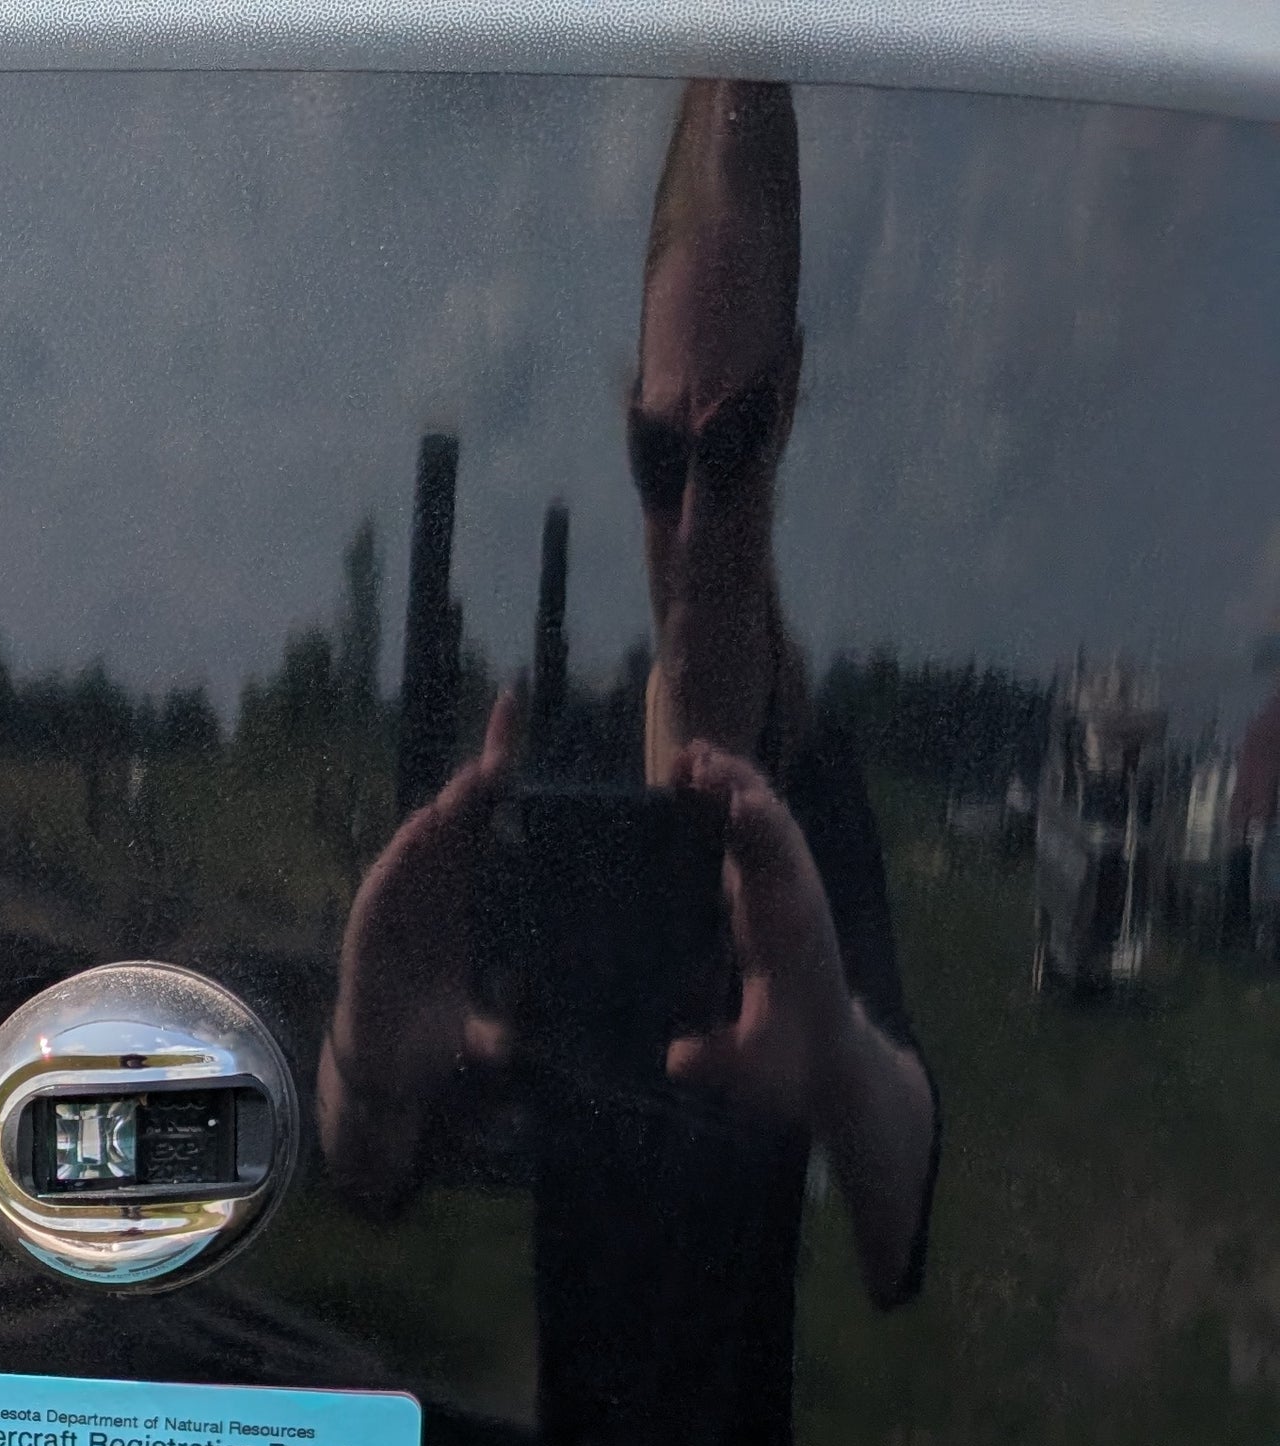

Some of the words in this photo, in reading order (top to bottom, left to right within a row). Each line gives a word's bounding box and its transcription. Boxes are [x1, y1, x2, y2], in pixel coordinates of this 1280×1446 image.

[46, 1409, 139, 1428] Department
[143, 1416, 159, 1430] of
[164, 1416, 223, 1434] Natural
[229, 1420, 316, 1439] Resources
